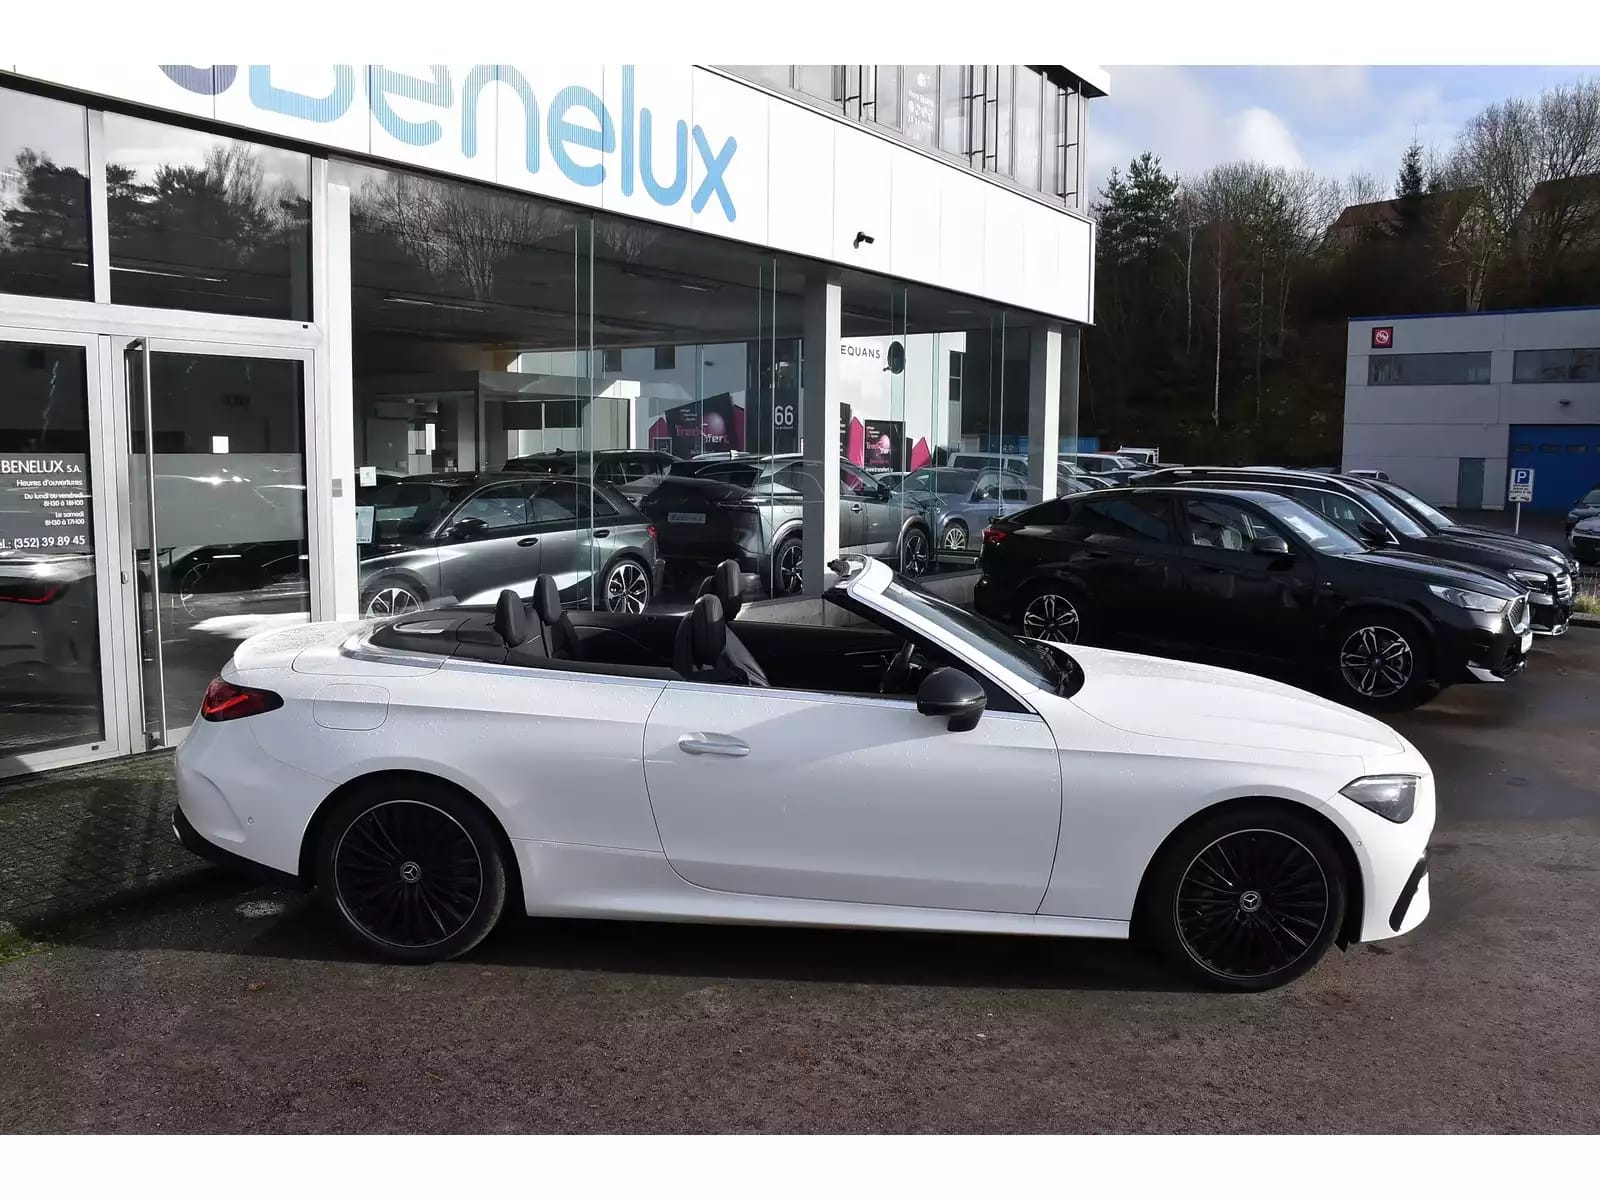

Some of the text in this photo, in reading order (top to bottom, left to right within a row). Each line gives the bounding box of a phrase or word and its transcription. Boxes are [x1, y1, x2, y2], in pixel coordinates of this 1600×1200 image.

[840, 344, 881, 359] EQUANS
[774, 405, 794, 425] 66
[1, 459, 64, 473] BENELUX
[1517, 471, 1527, 483] P
[14, 537, 40, 550] (352)
[41, 536, 55, 547] 39
[57, 535, 71, 546] 89
[72, 535, 86, 545] 45
